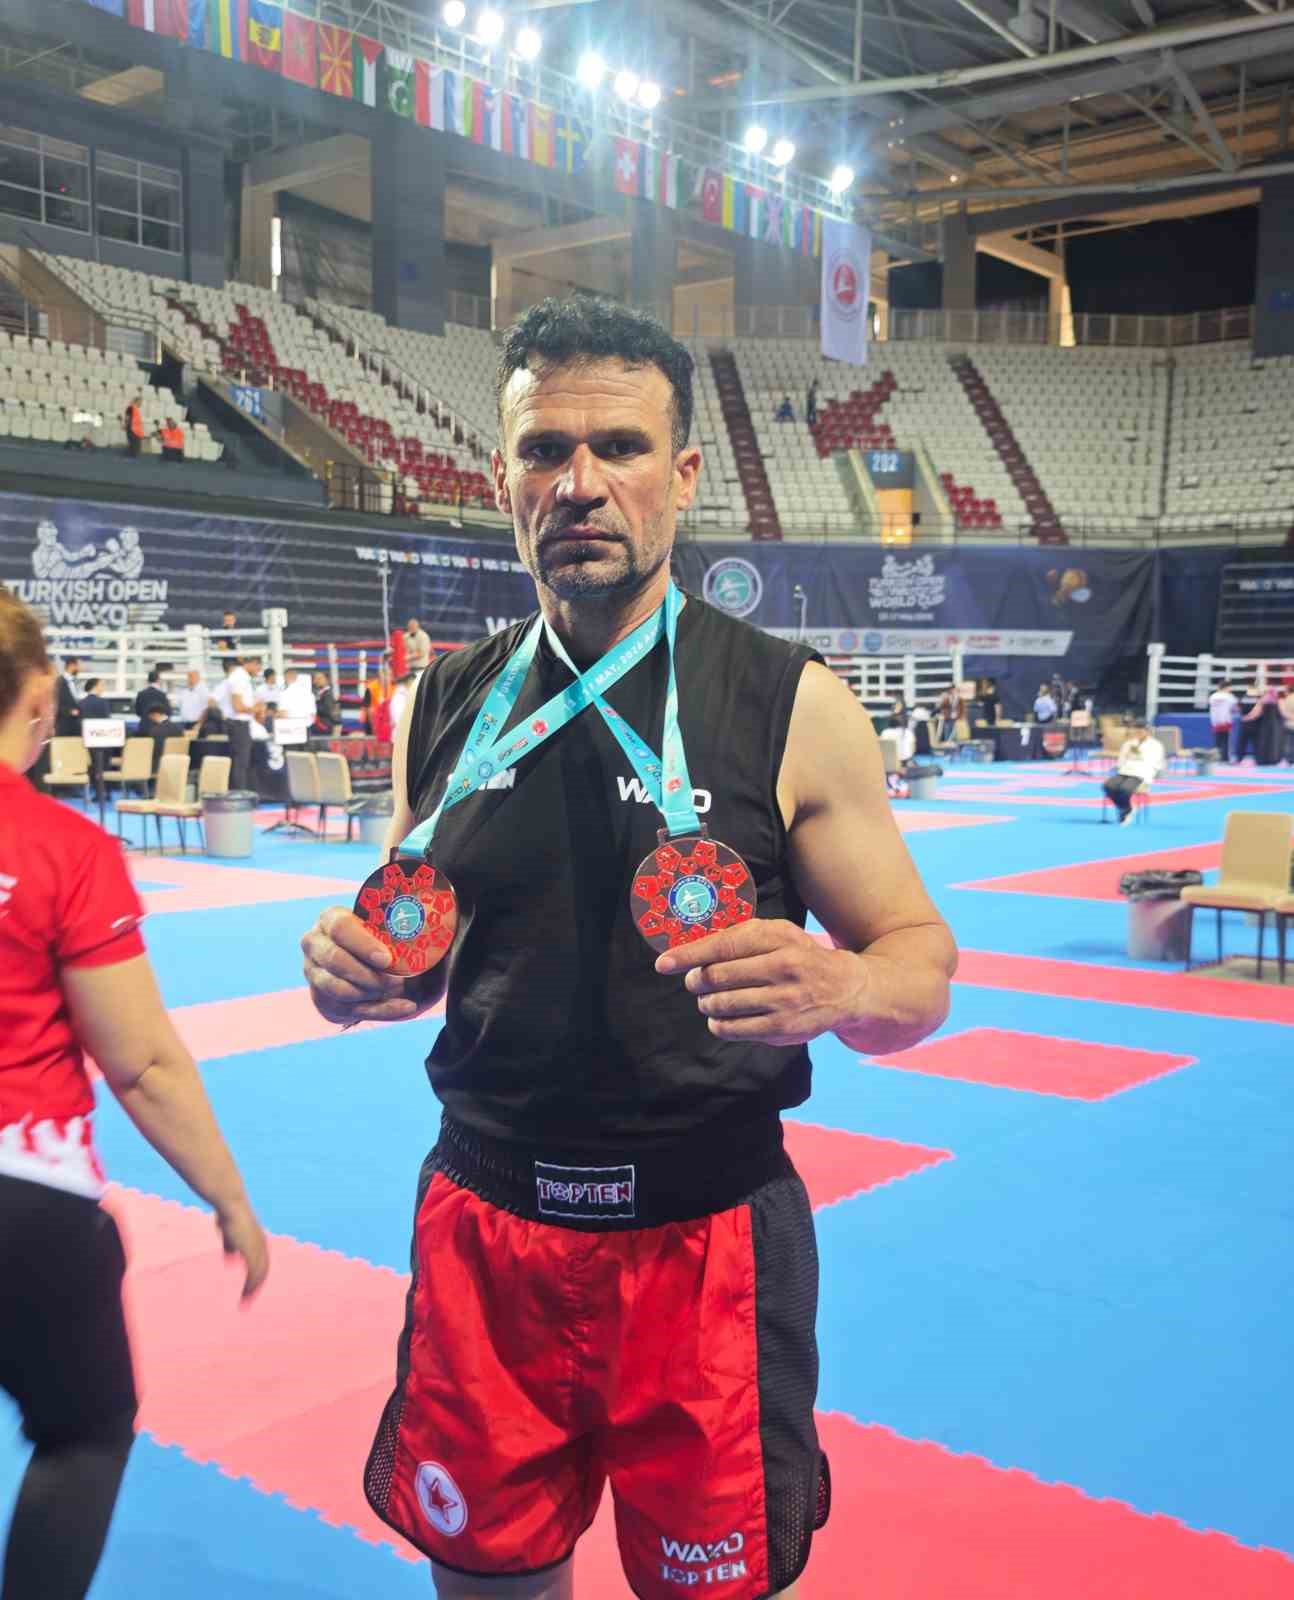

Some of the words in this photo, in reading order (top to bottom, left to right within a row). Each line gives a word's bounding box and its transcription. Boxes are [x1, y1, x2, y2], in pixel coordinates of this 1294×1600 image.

[2, 579, 105, 602] TURKISH
[107, 579, 168, 602] OPEN
[50, 602, 129, 625] WAKO
[616, 776, 712, 814] WO
[660, 1532, 744, 1563] WAKO
